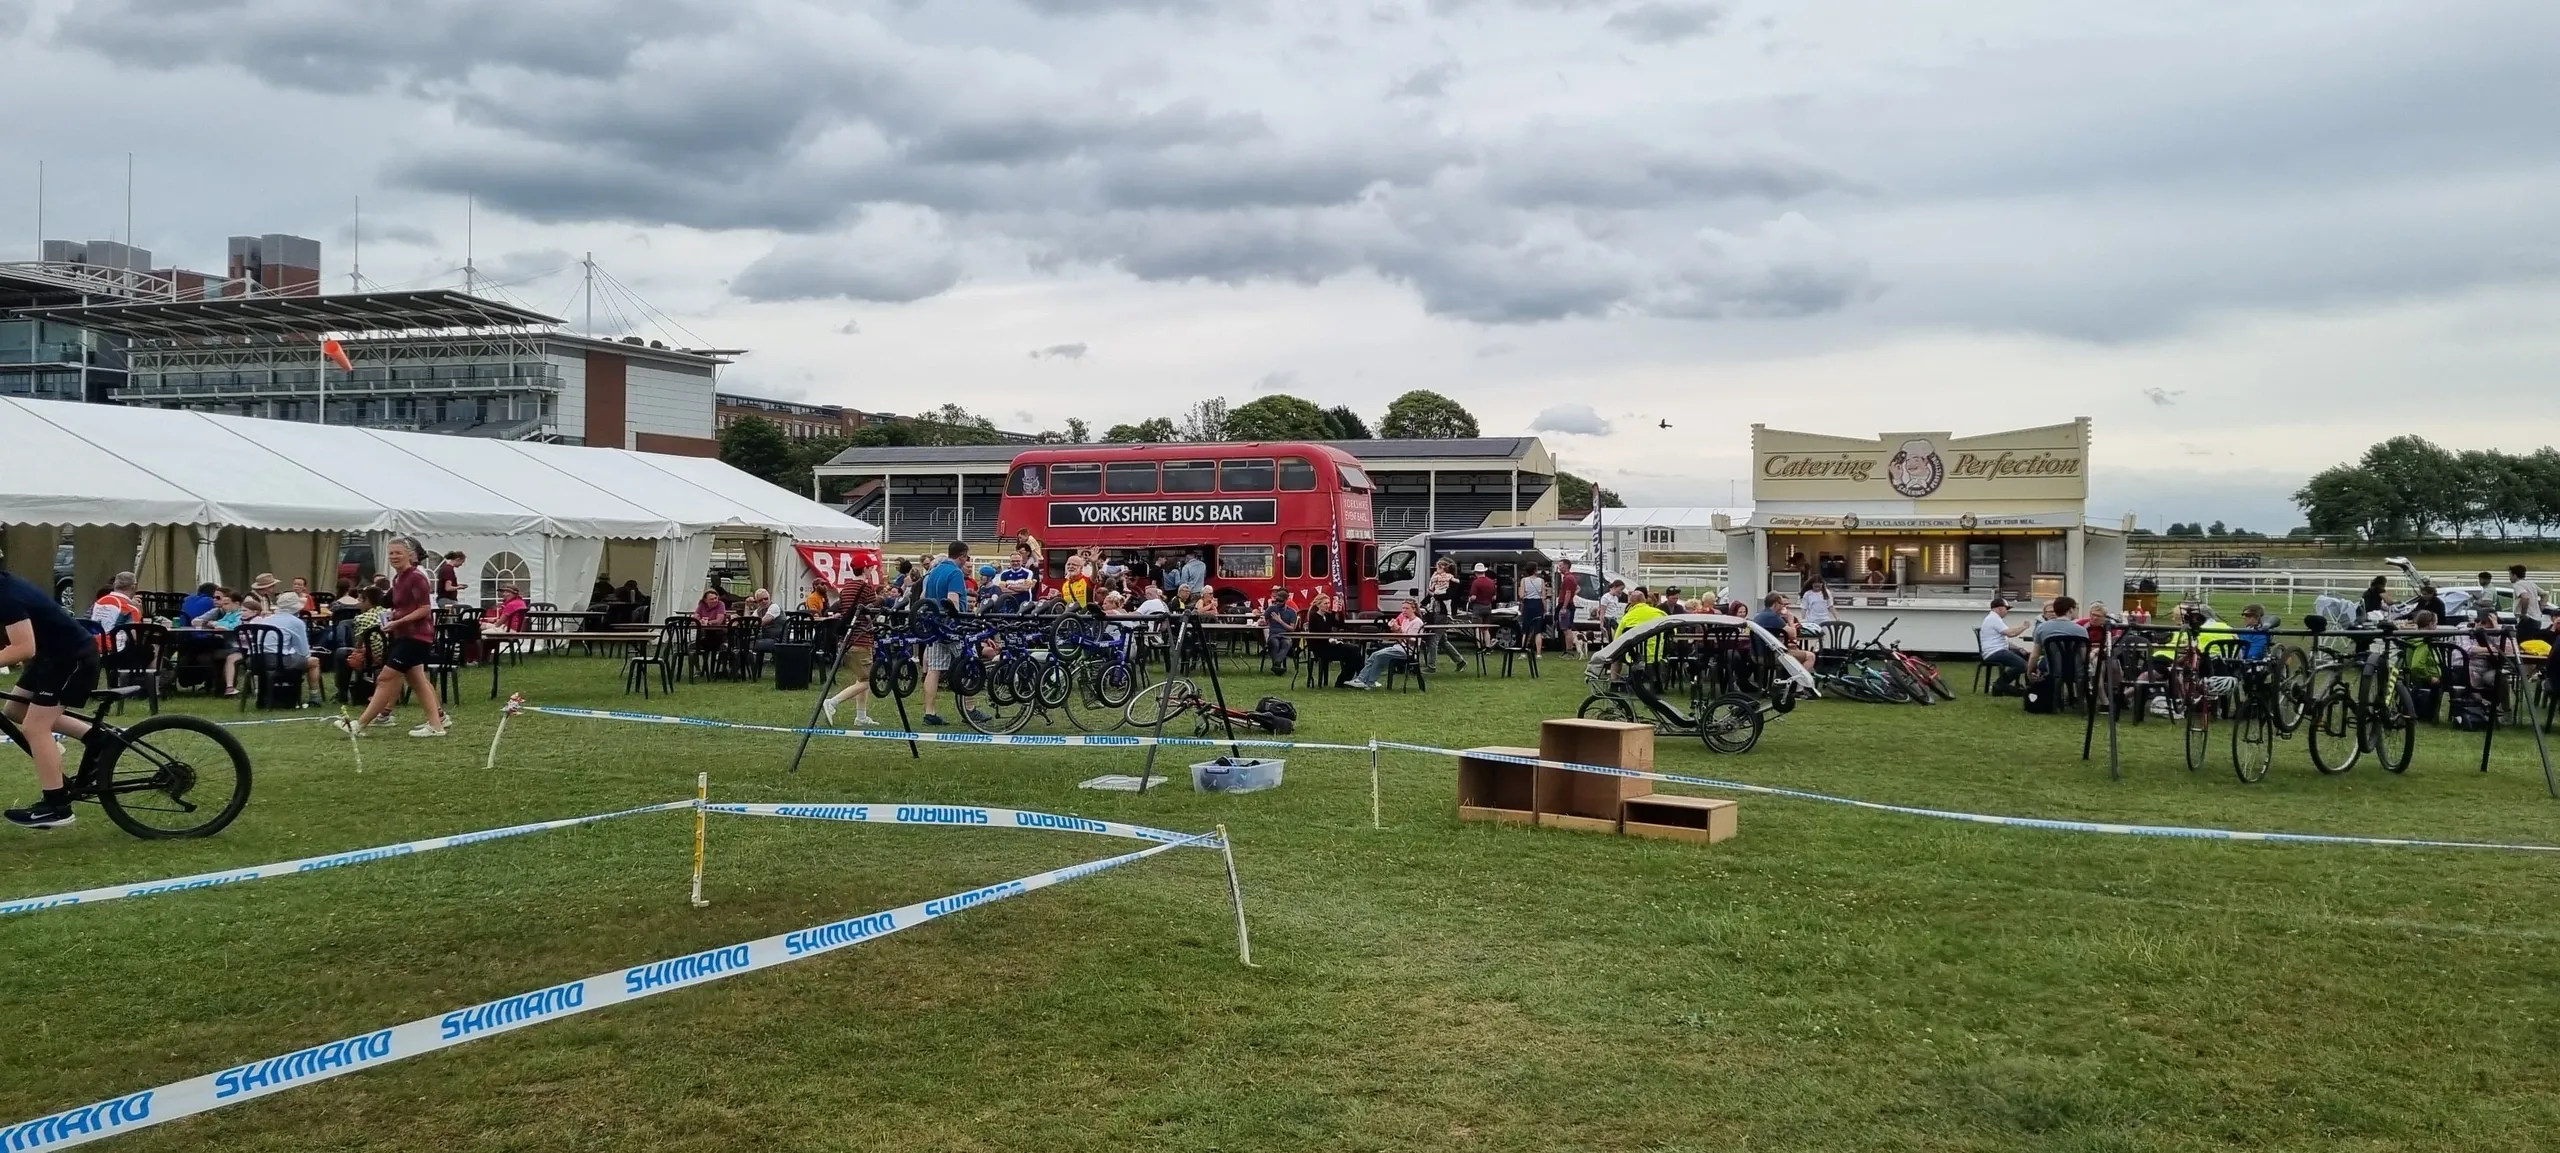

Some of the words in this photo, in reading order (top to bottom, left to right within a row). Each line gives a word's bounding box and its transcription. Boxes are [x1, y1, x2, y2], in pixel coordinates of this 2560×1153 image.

[1764, 453, 1877, 483] Catering
[1950, 451, 2080, 481] Perfection
[1900, 484, 1926, 496] CATERING
[1078, 506, 1167, 523] YORKSHIRE
[1172, 505, 1204, 522] BUS
[1209, 504, 1243, 521] BAR
[1769, 517, 1801, 526] Catering
[1801, 517, 1836, 527] Perfection
[936, 732, 993, 743] SHIMANO
[1010, 735, 1066, 745] SHIMANO
[1084, 735, 1140, 745] SHIMANO
[897, 807, 988, 824] SHIMANO
[1016, 812, 1107, 832] SHIMANO
[0, 1092, 154, 1153] IMANO
[215, 1030, 392, 1099] SHIMANO
[441, 982, 584, 1040] SHIMANO
[625, 945, 749, 993] SHIMANO
[785, 913, 894, 955] SHIMANO
[925, 881, 1025, 916] SHIM
